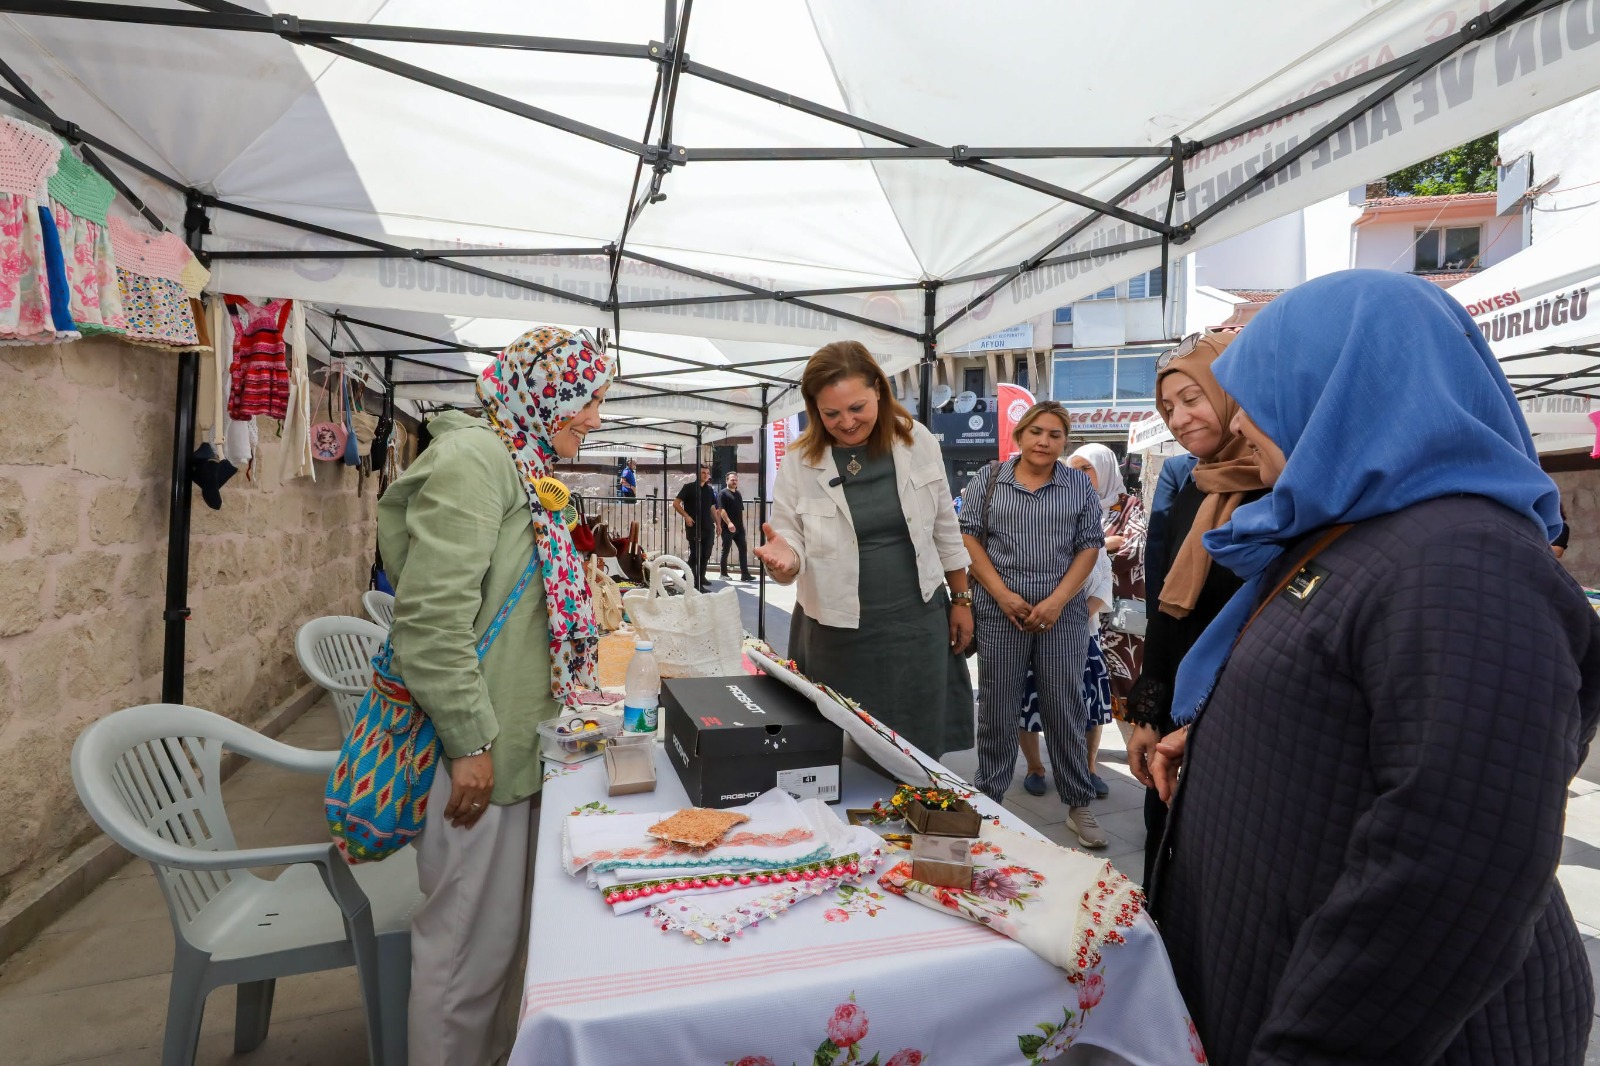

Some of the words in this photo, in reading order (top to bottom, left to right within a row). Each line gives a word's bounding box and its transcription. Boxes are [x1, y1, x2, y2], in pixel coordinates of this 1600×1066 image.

[1465, 287, 1521, 318] DİYESİ
[1478, 287, 1590, 344] DÜRLÜĞÜ
[980, 340, 1005, 349] AFYON
[726, 685, 766, 714] PROSHOT
[720, 791, 761, 801] PROSHOT
